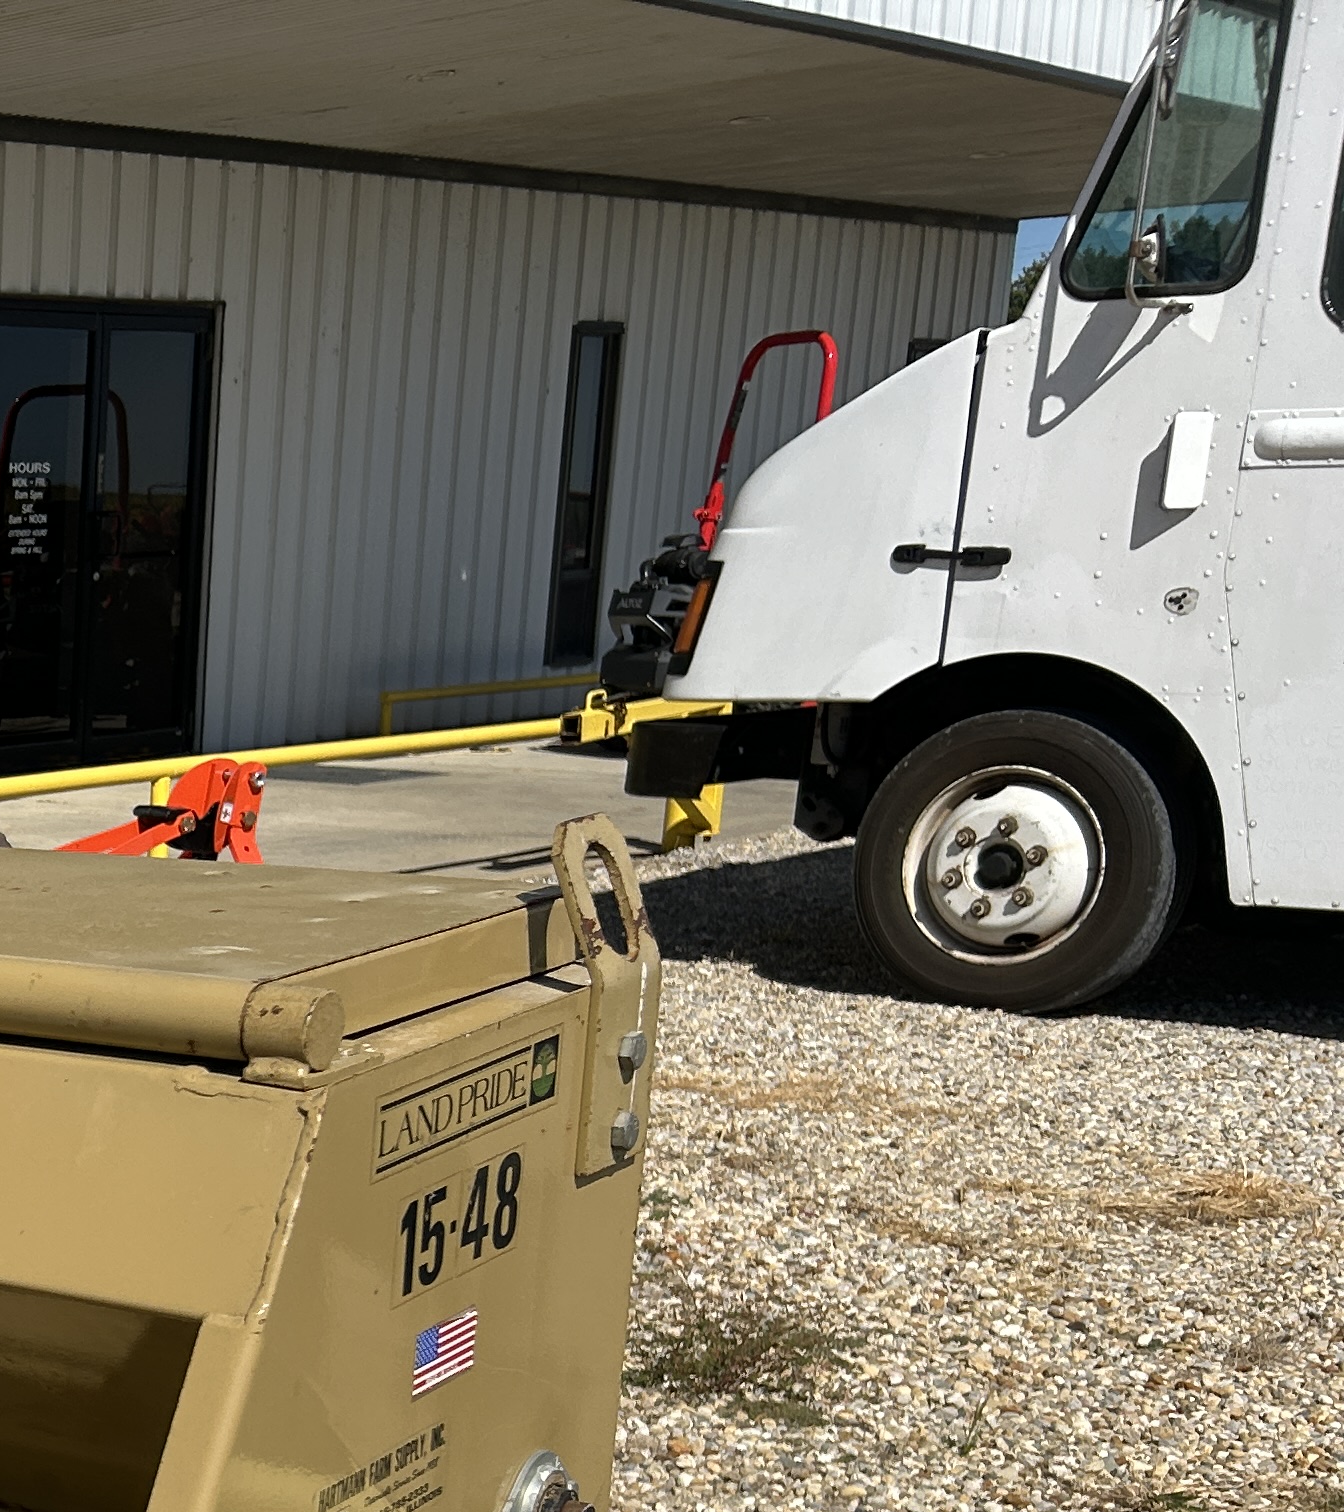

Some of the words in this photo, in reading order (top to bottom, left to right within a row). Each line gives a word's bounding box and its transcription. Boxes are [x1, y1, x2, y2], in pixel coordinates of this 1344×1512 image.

[8, 462, 51, 474] HOURS
[377, 1096, 452, 1160] LAND
[455, 1060, 529, 1126] PRIDE
